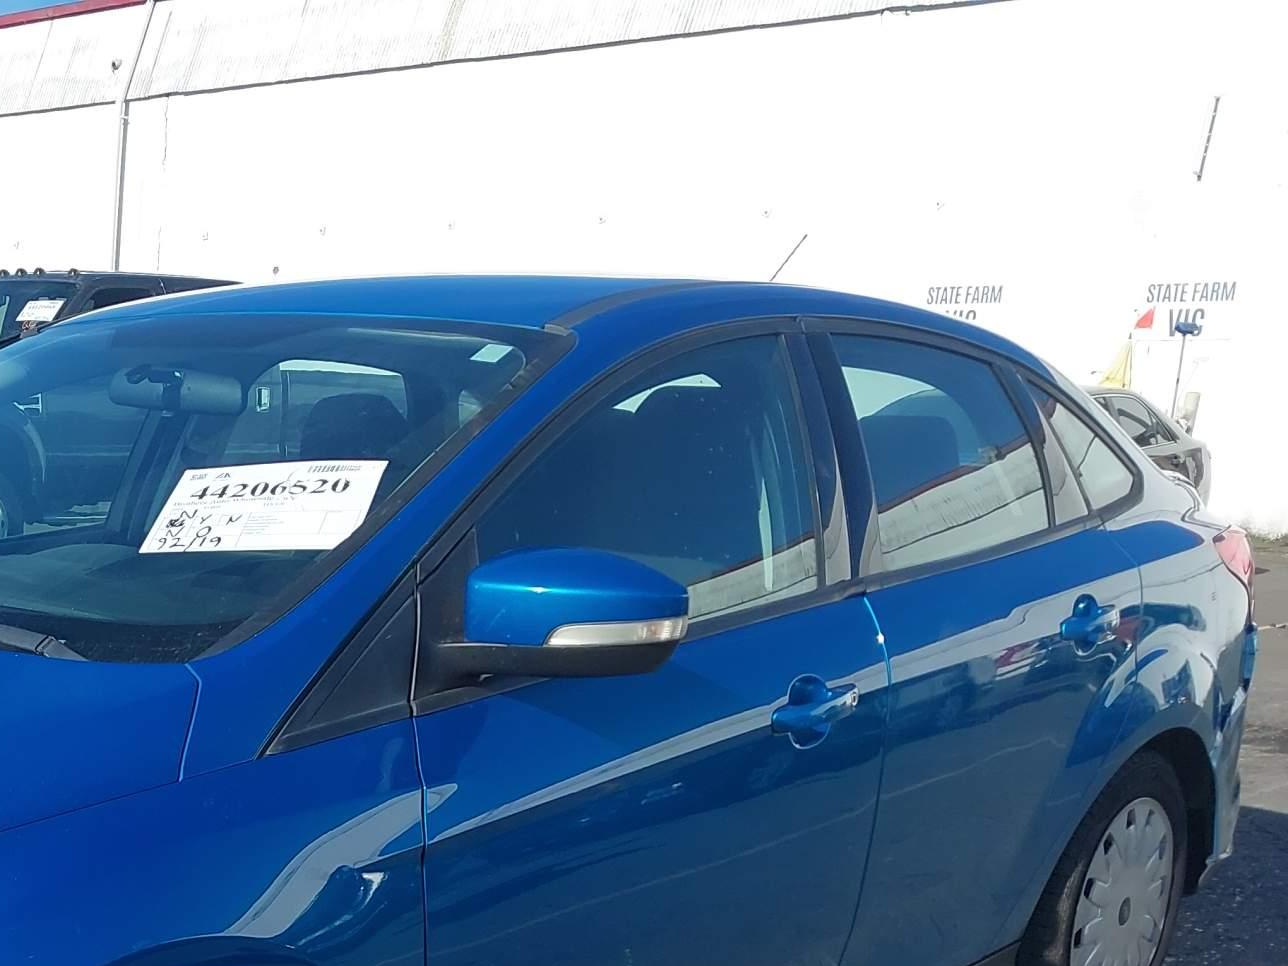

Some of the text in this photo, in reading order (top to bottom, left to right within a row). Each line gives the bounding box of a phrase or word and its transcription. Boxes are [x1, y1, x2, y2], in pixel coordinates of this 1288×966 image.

[926, 285, 1003, 305] STATE FARM
[1146, 281, 1237, 303] STATE FARM
[190, 478, 351, 500] 44206520
